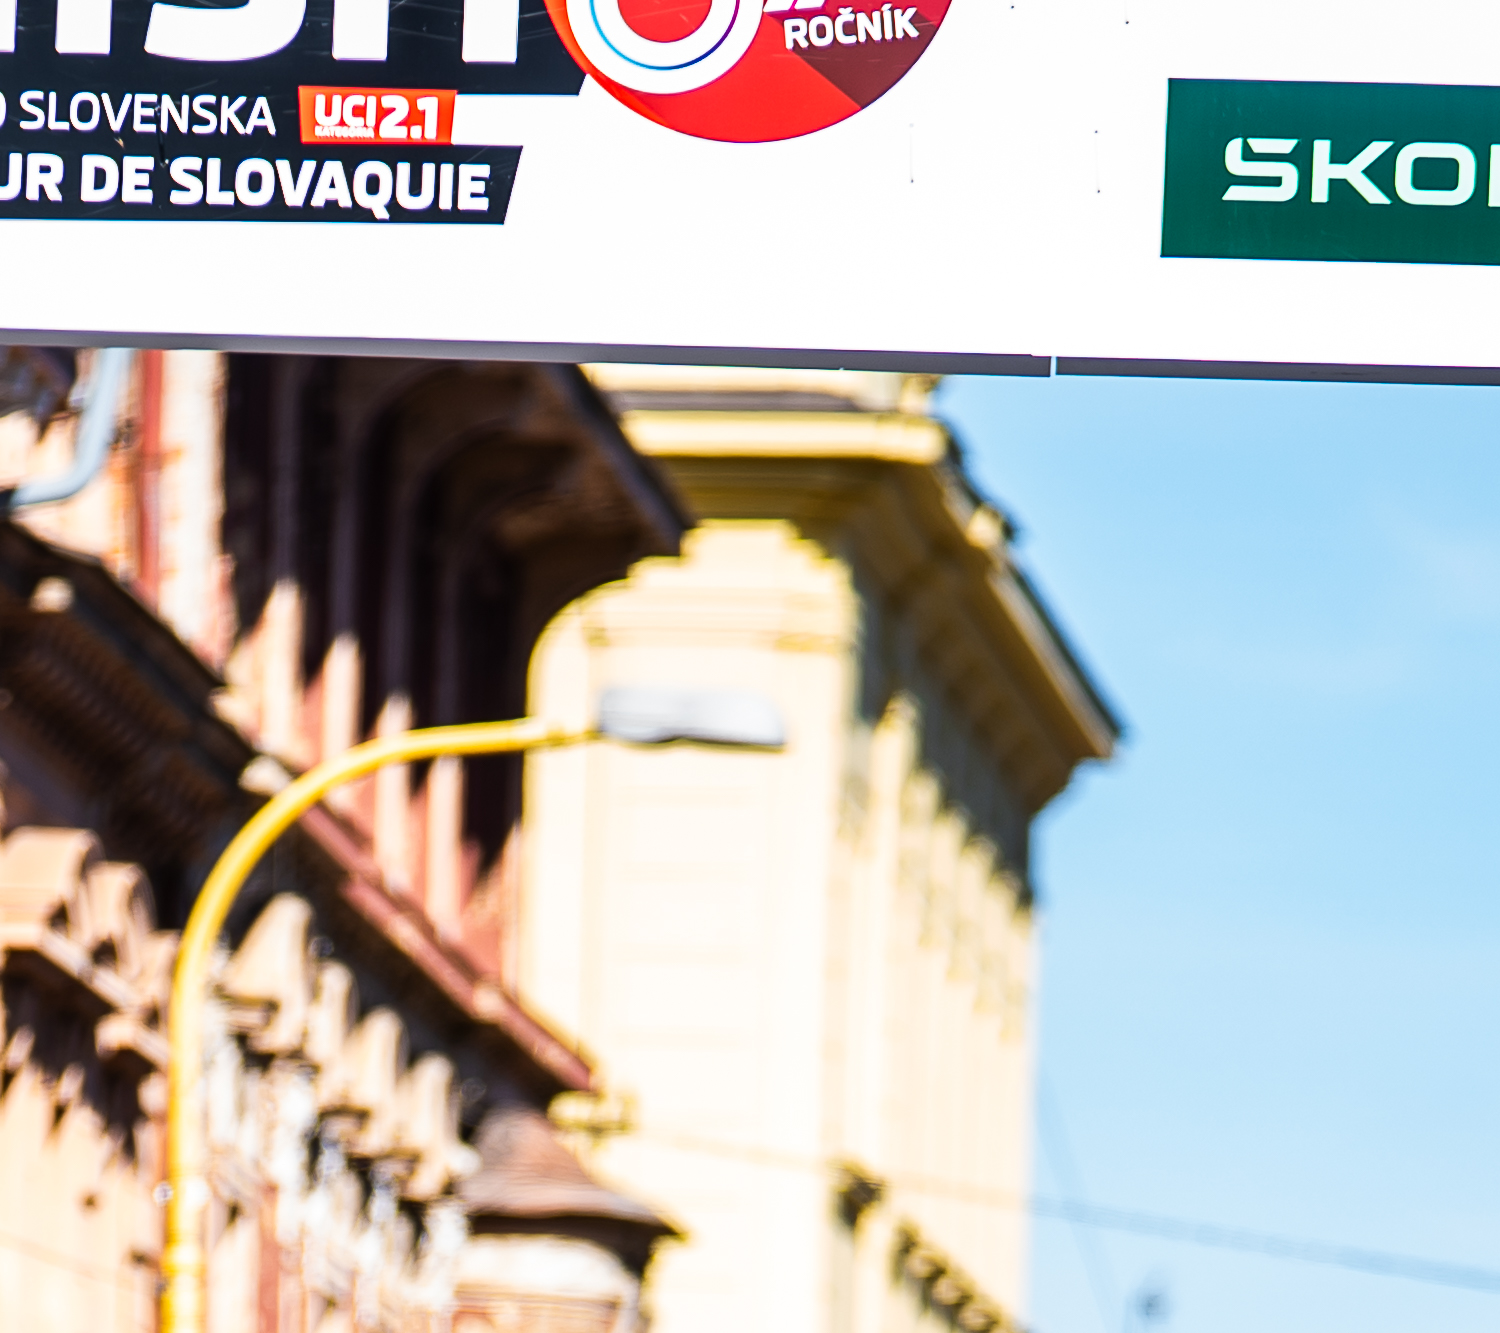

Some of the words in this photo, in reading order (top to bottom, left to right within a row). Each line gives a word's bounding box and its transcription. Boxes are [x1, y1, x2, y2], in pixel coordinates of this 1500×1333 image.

[782, 4, 920, 51] ROČNÍK
[19, 90, 276, 136] SLOVENSKA
[315, 93, 377, 127] UCI
[379, 94, 438, 140] 2.1
[81, 154, 153, 204] DE
[168, 155, 490, 219] SLOVAQUIE
